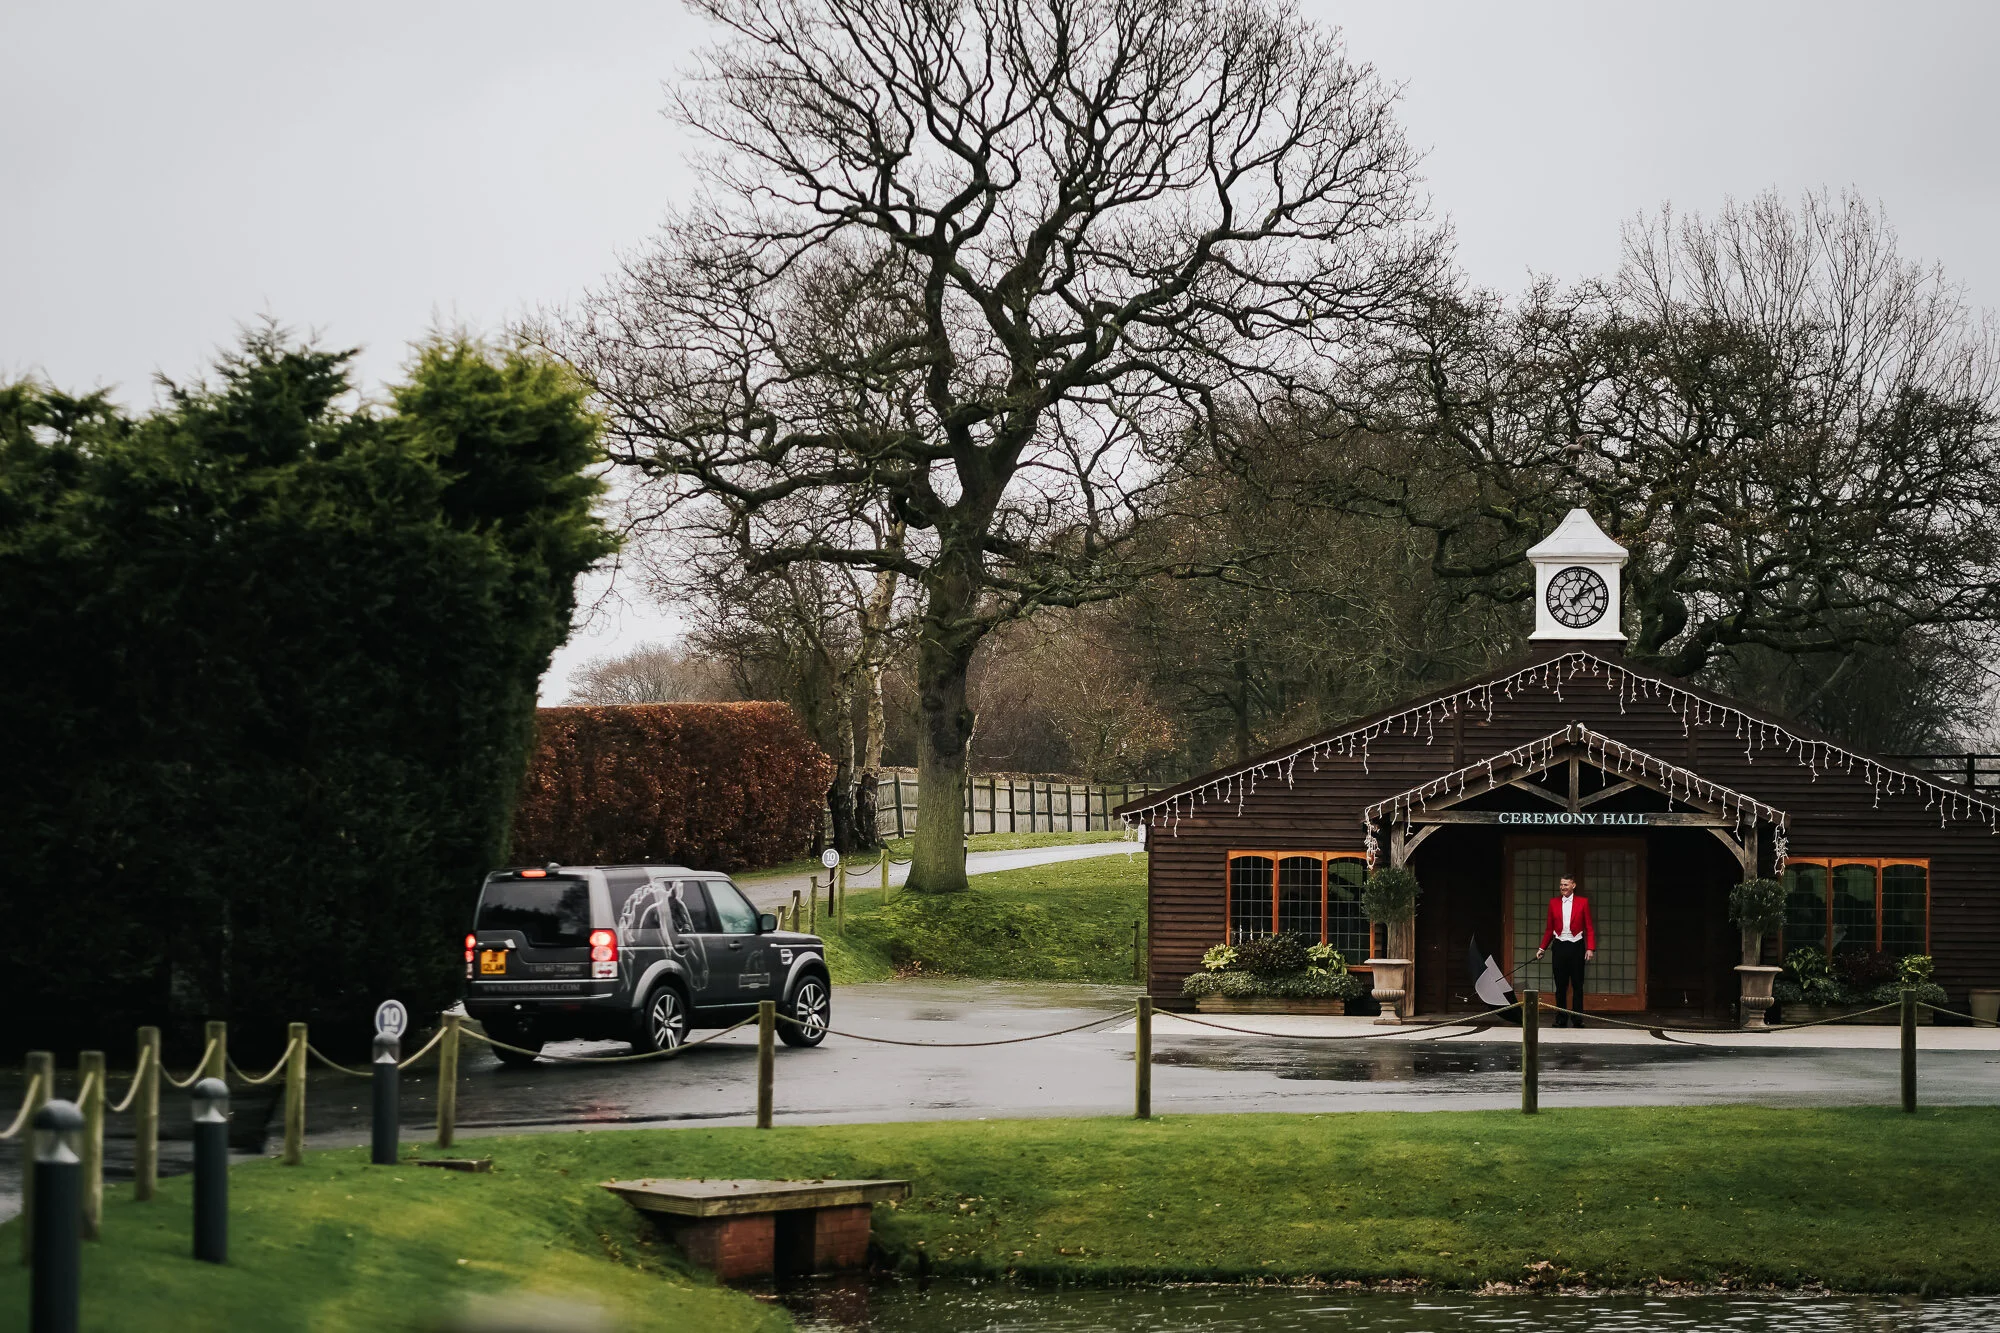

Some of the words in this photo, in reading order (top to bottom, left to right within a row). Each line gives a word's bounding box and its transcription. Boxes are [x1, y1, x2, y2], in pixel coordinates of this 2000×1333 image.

[1498, 812, 1598, 825] CEREMONY
[1602, 813, 1649, 825] HALL
[826, 852, 836, 861] 10
[382, 1007, 401, 1025] 10
